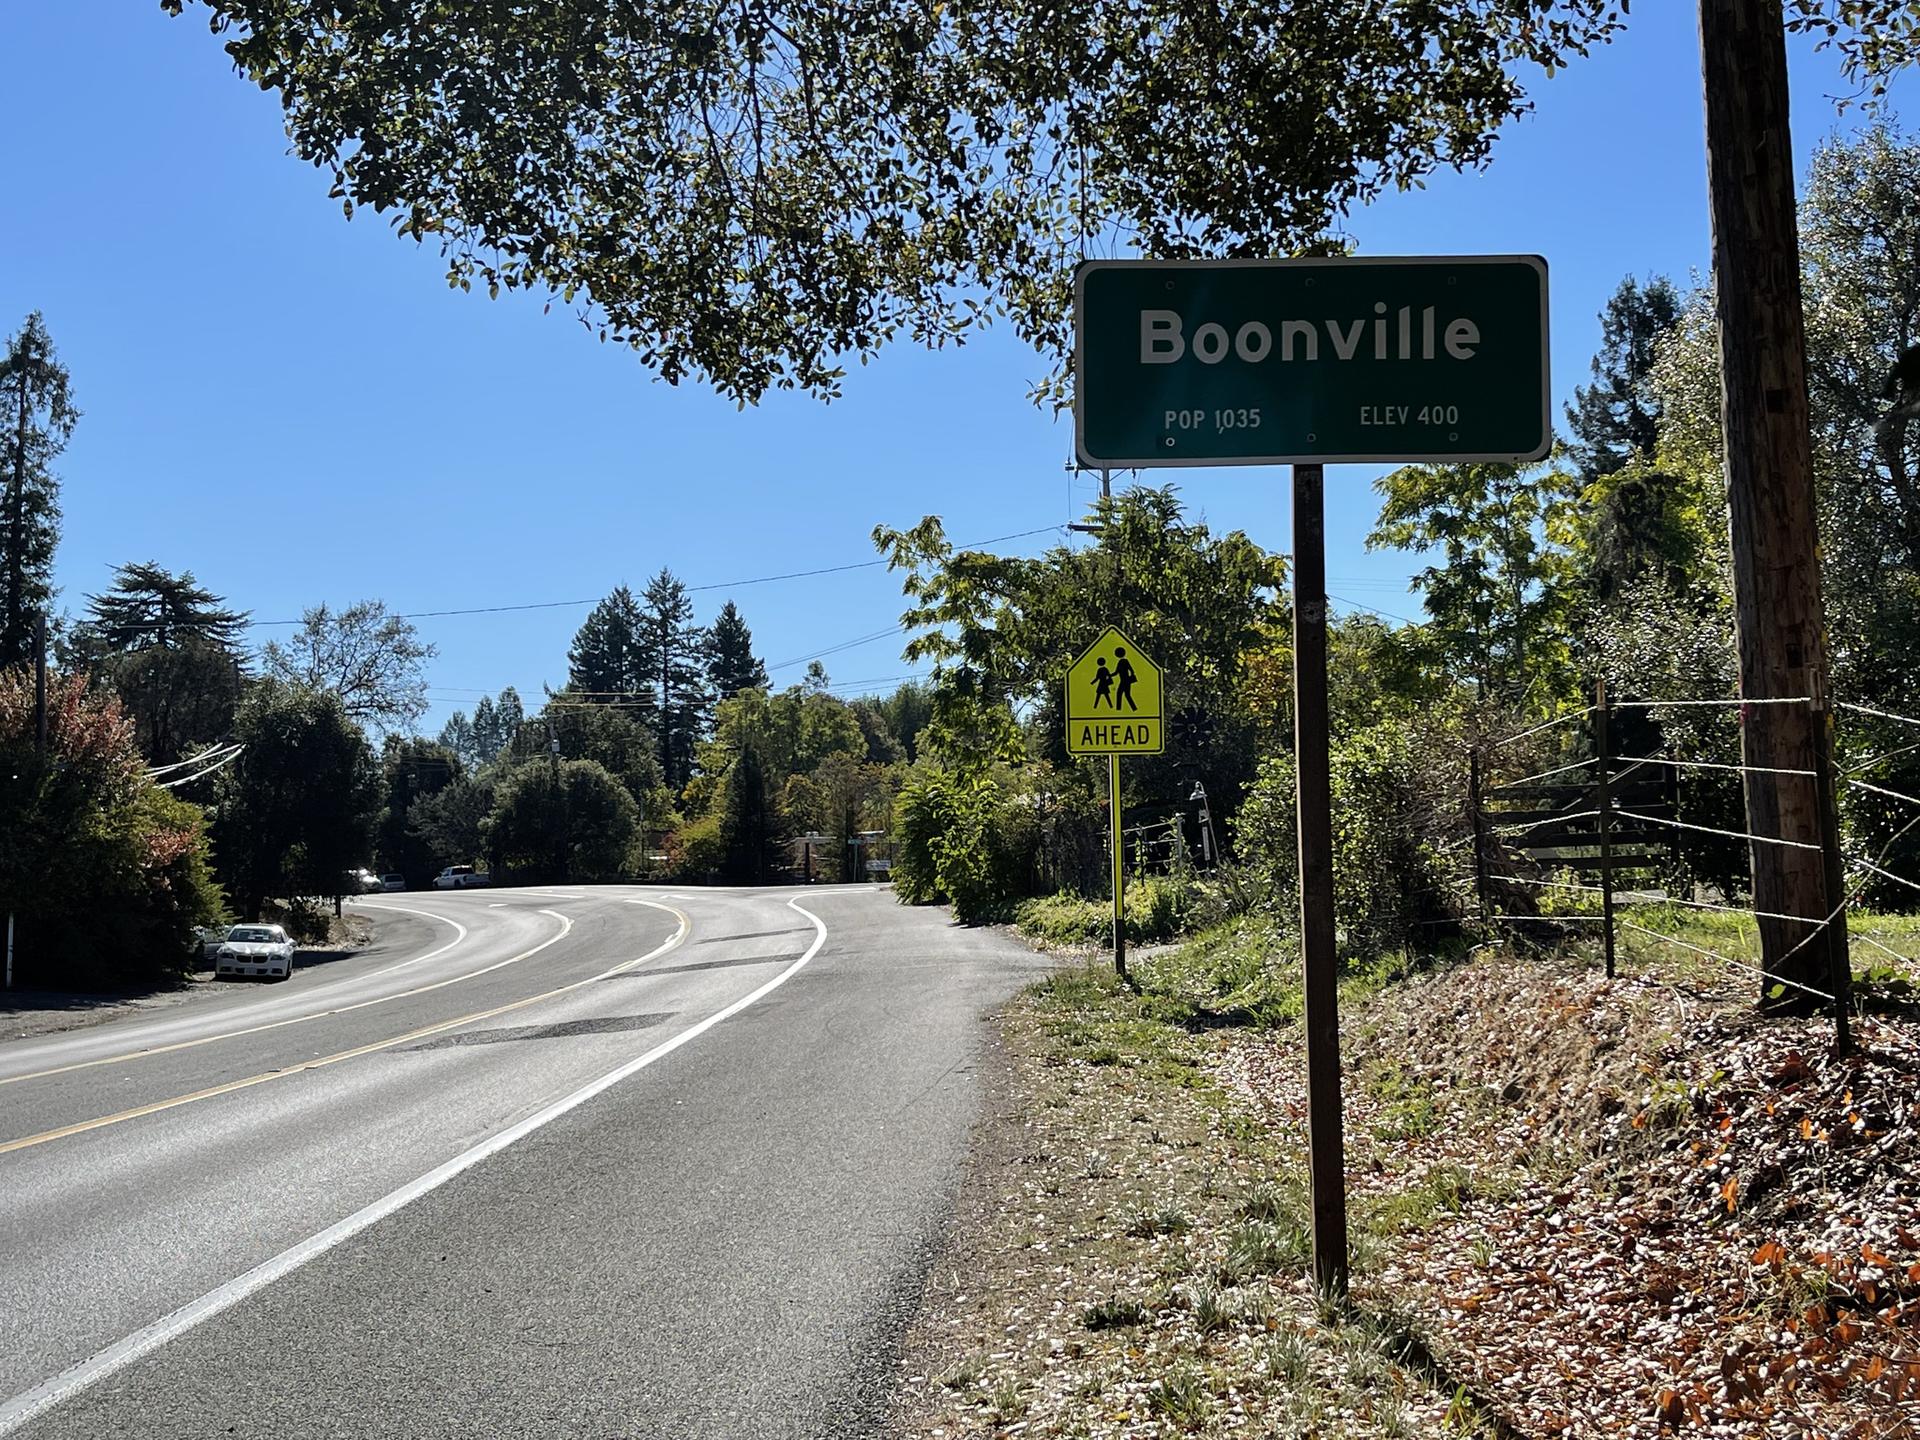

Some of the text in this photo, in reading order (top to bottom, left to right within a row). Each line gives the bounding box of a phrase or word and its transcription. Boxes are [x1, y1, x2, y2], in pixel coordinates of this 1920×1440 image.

[1140, 301, 1481, 365] Boonville
[1165, 408, 1261, 434] POP 1,035
[1360, 405, 1459, 425] ELEV 400
[1081, 725, 1150, 745] AHEAD
